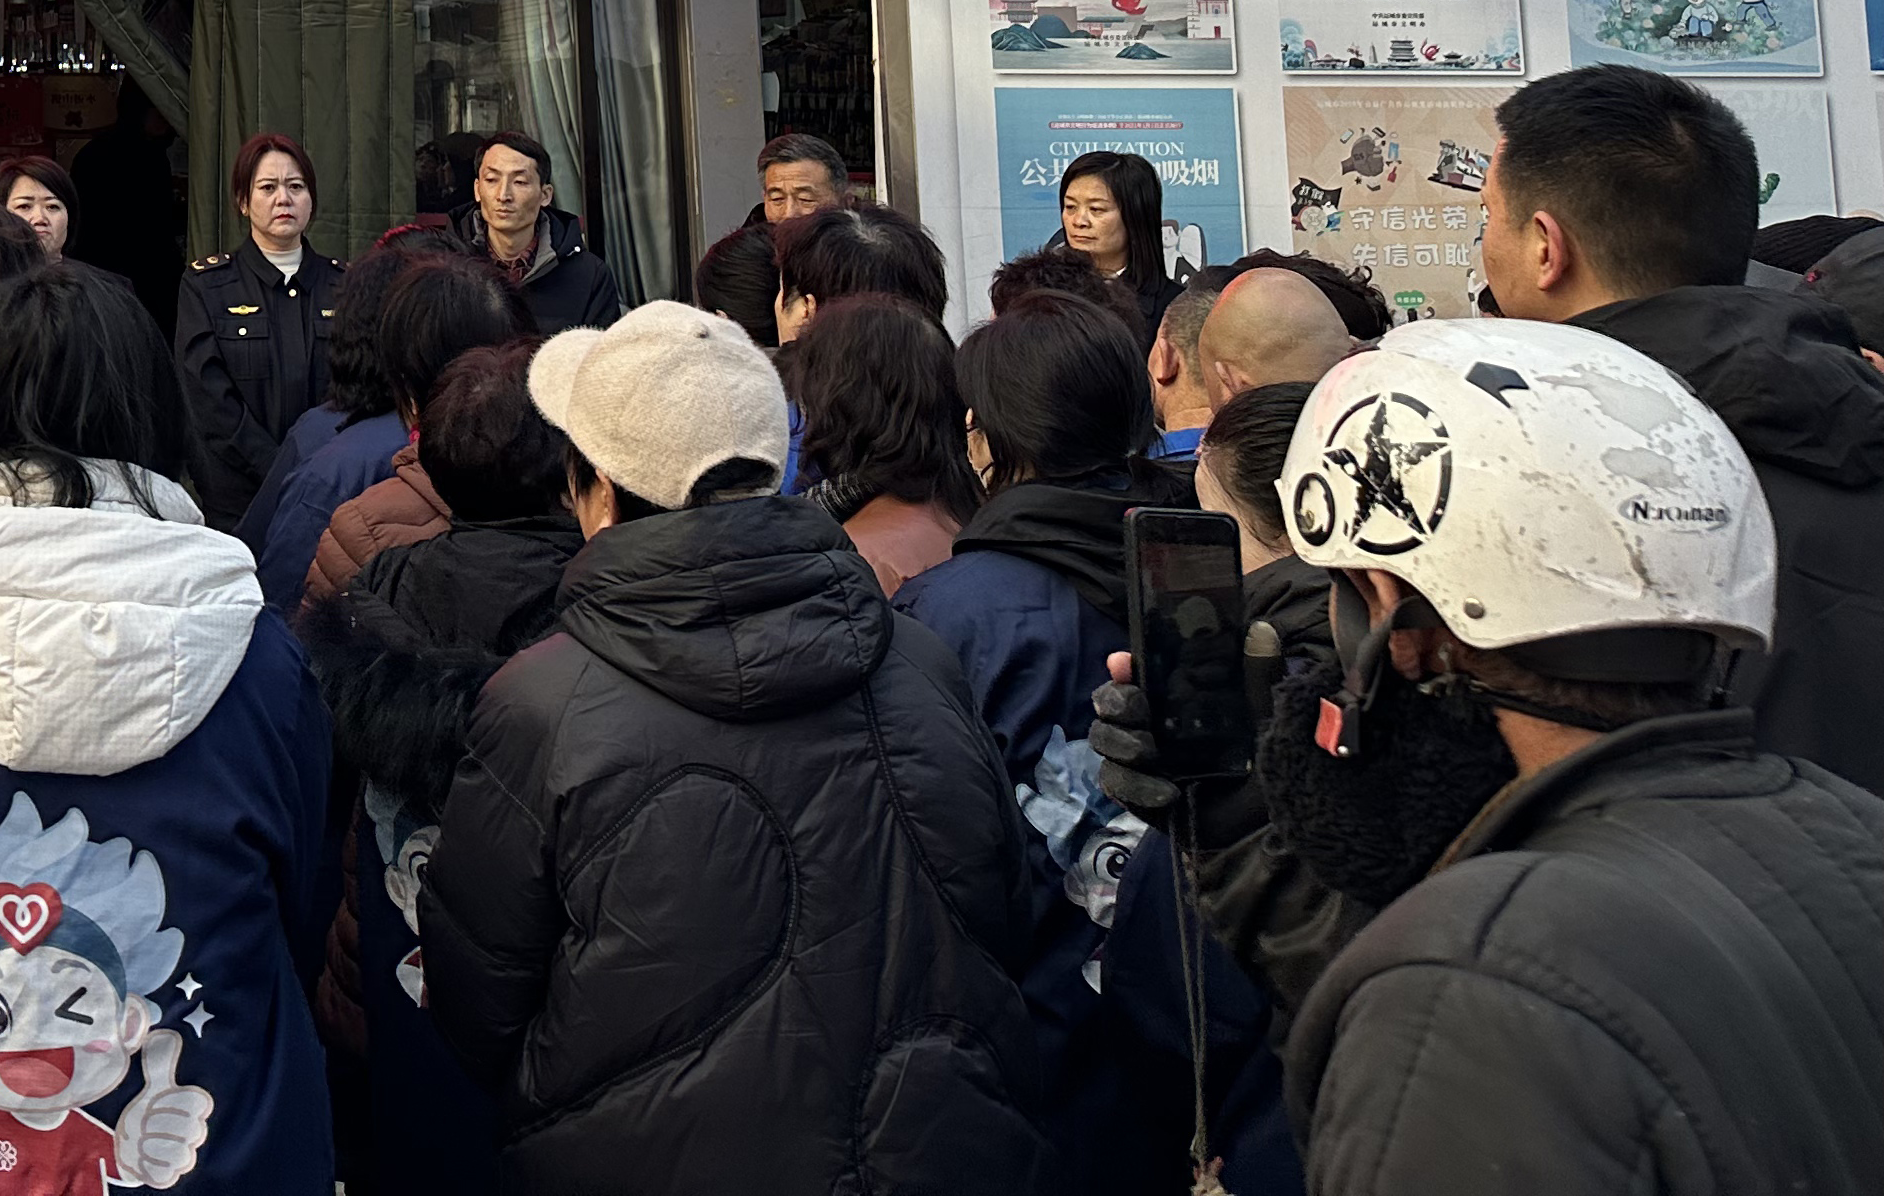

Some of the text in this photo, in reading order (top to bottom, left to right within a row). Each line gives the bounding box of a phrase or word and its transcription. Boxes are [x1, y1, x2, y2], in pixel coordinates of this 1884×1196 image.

[1049, 142, 1185, 155] CIVILIZATION
[1349, 206, 1468, 230] 守信光荣
[1353, 243, 1471, 267] 失信可耻
